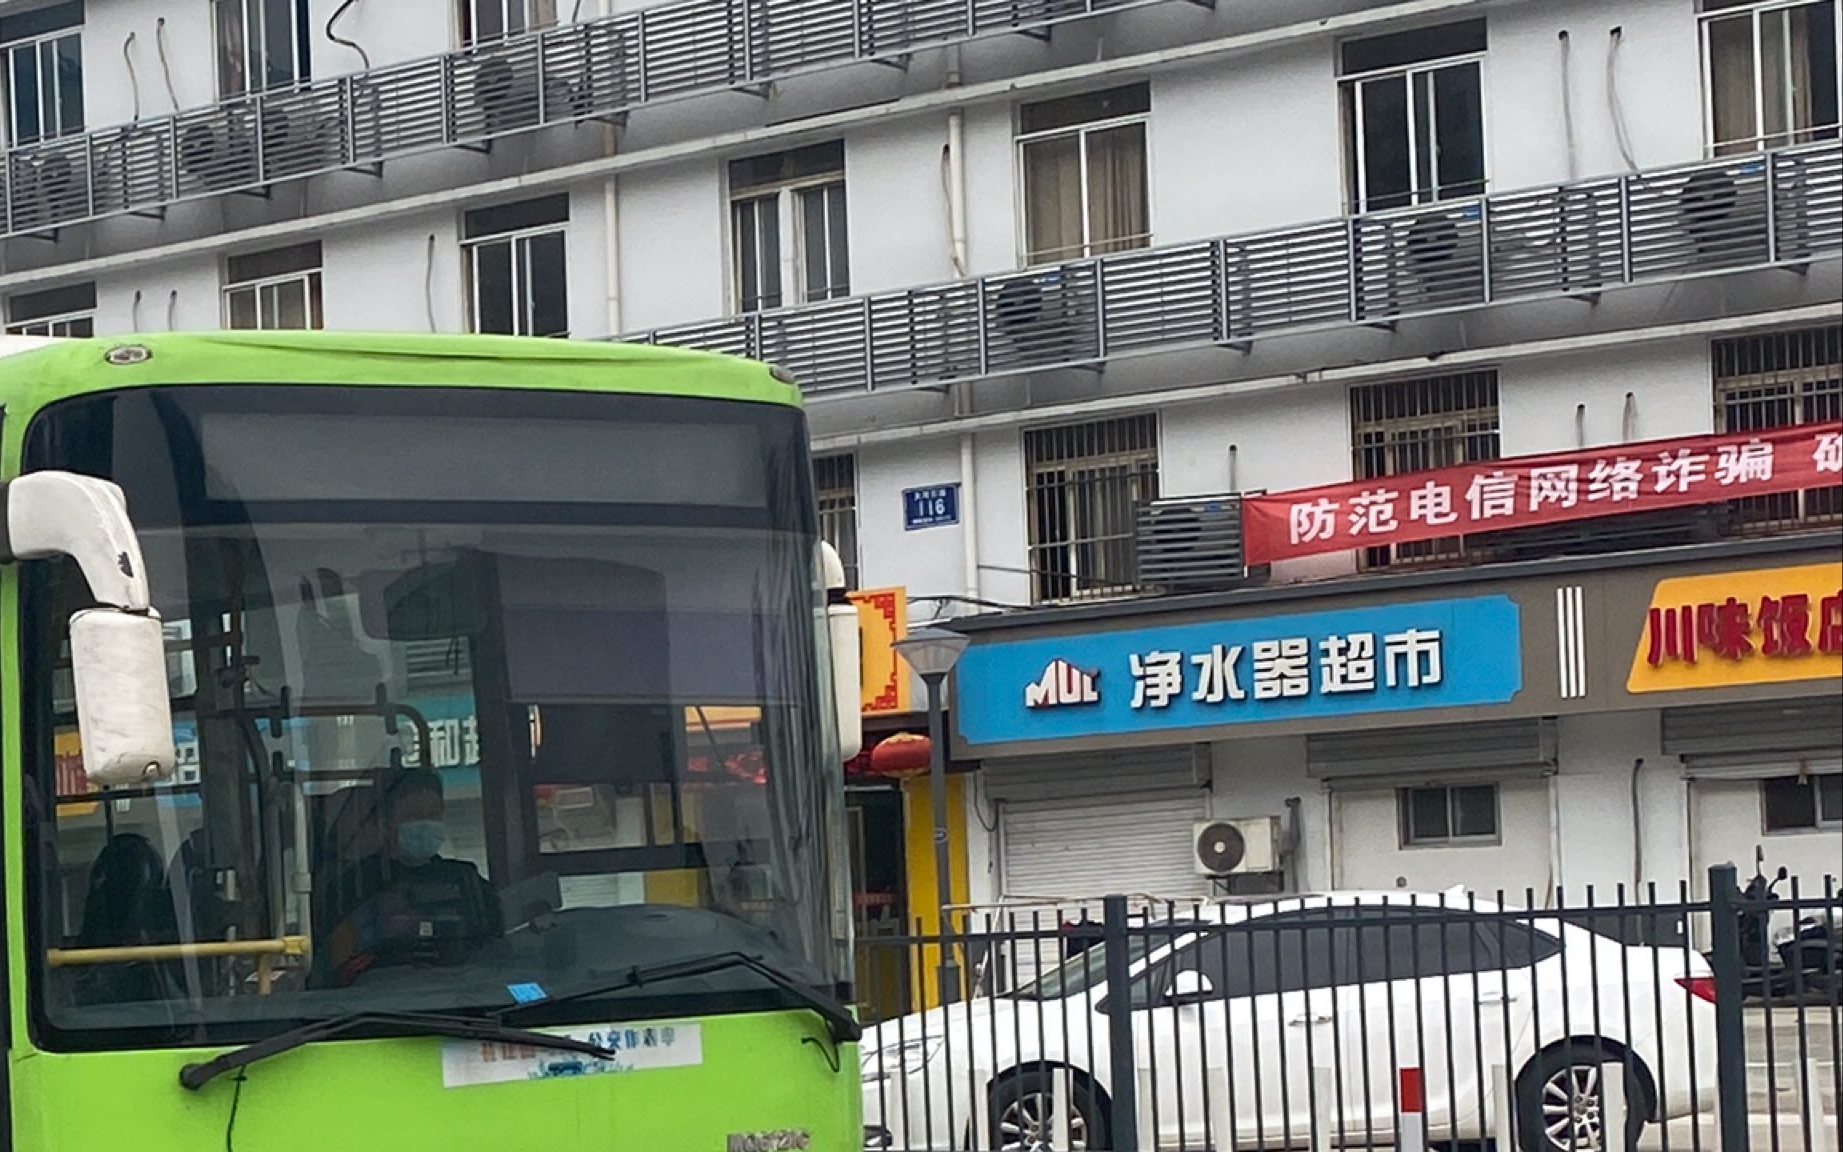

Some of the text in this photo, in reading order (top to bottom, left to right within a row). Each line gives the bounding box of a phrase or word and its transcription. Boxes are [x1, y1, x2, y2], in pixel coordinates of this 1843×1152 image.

[918, 498, 946, 516] 116
[1289, 438, 1773, 545] 防范电信网络诈骗
[1128, 628, 1442, 709] 净水器超市
